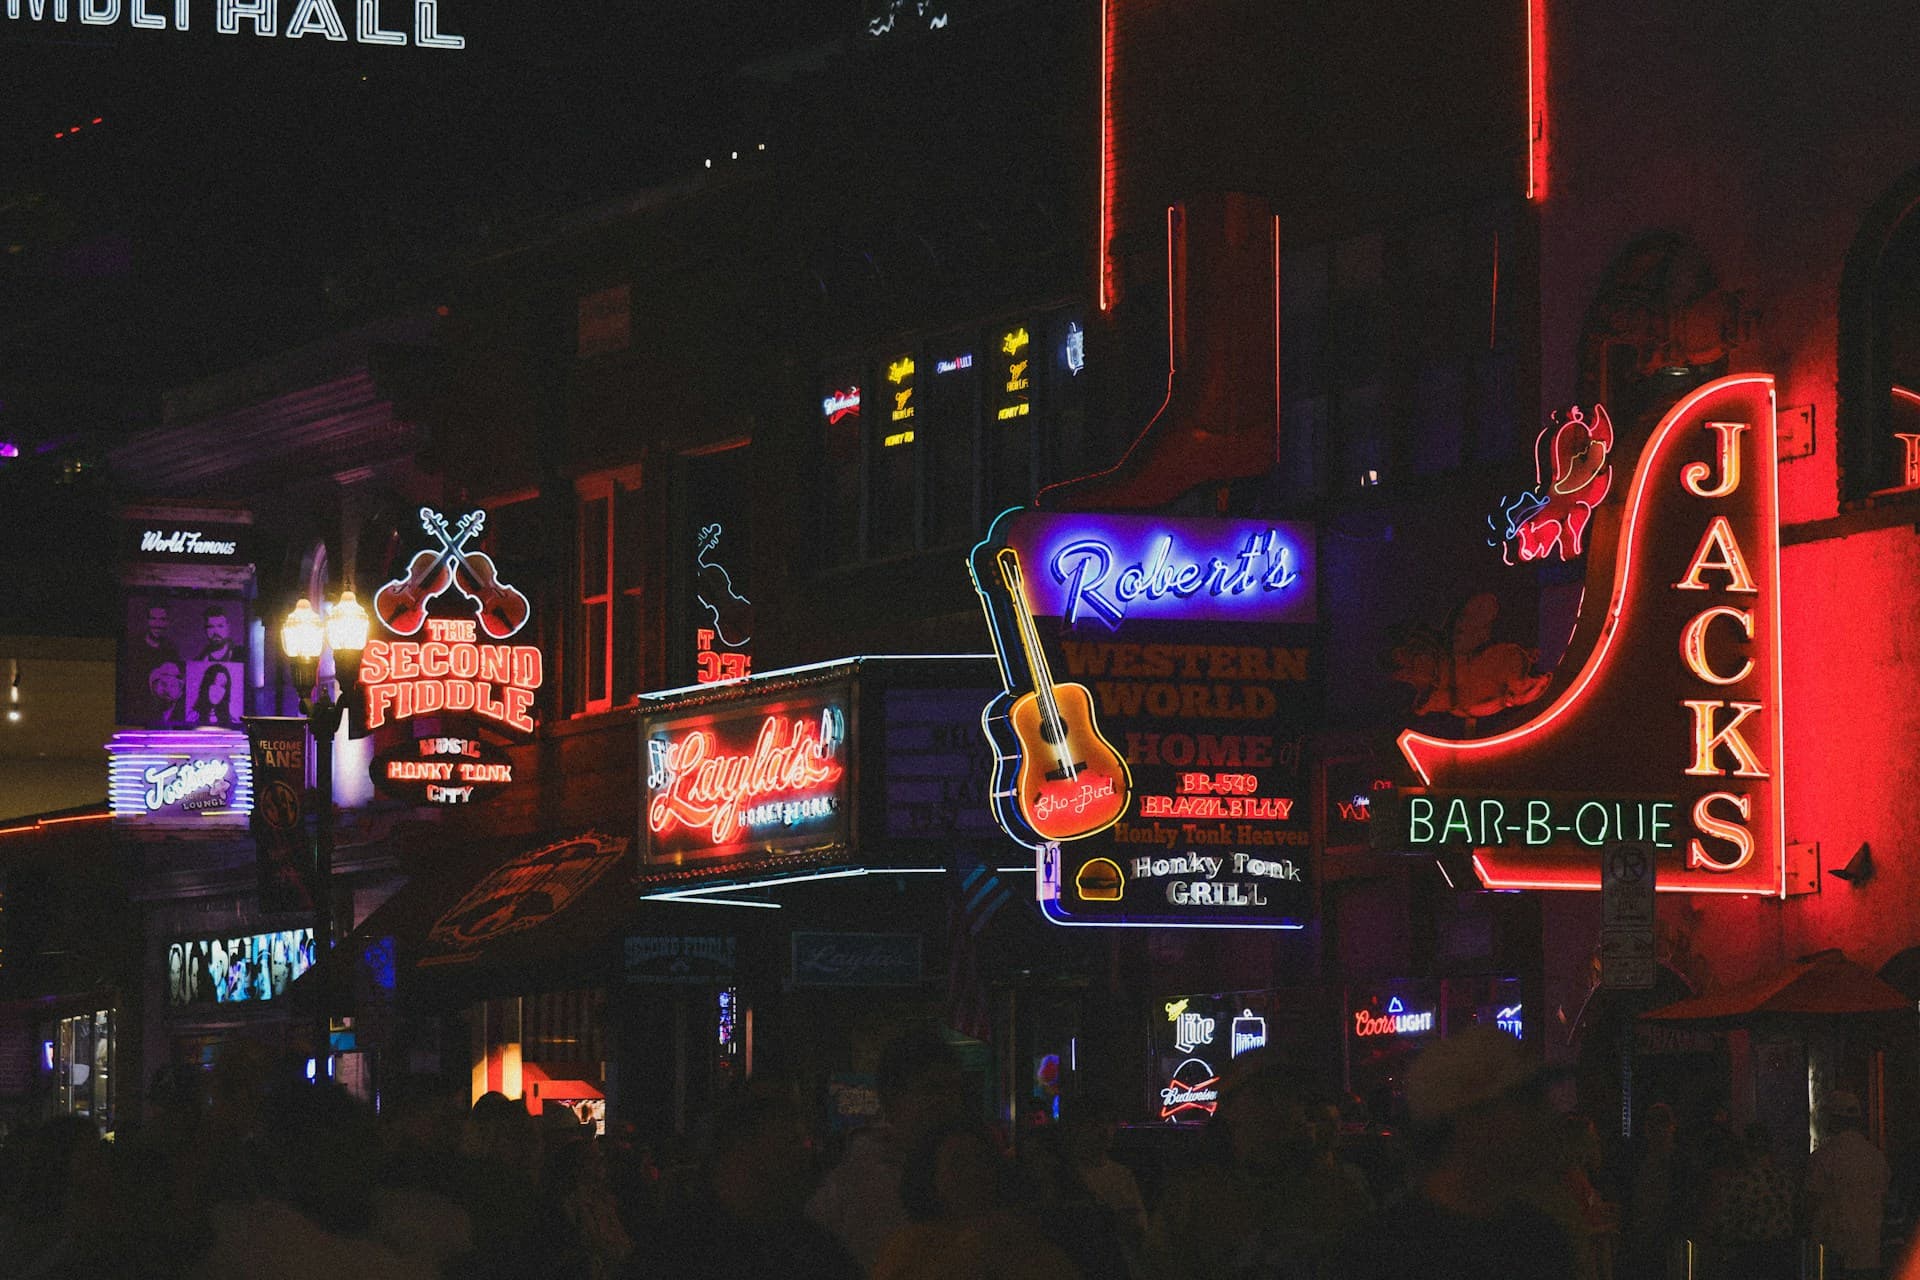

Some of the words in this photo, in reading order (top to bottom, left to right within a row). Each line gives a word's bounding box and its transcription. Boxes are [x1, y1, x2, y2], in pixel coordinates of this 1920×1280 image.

[216, 0, 465, 49] HALL
[141, 530, 186, 553] World
[185, 531, 237, 555] Famous
[1052, 527, 1297, 632] Robert's
[427, 619, 477, 642] THE
[1060, 640, 1310, 681] WESTERN
[1672, 420, 1770, 873] JACKS
[359, 639, 544, 690] SECOND
[367, 680, 535, 734] FIDDLE
[1096, 681, 1278, 720] WORLD
[254, 750, 303, 768] ANS
[419, 737, 481, 759] MUSIC
[1126, 732, 1274, 767] HOME
[387, 761, 454, 780] HONKY
[460, 764, 512, 783] TONK
[650, 714, 832, 844] Layla's
[1176, 771, 1259, 796] BR-549
[182, 798, 226, 811] LOUNGE
[426, 784, 474, 804] CITY
[1114, 822, 1178, 848] Honky
[1182, 823, 1232, 845] Tonk
[1237, 825, 1310, 846] Heaven
[1129, 851, 1224, 880] Honky
[1229, 851, 1301, 882] Tonk
[1166, 880, 1268, 906] GRILL
[1174, 1012, 1216, 1054] Lite
[1355, 1009, 1397, 1037] Coors
[1396, 1012, 1432, 1033] LIGHT
